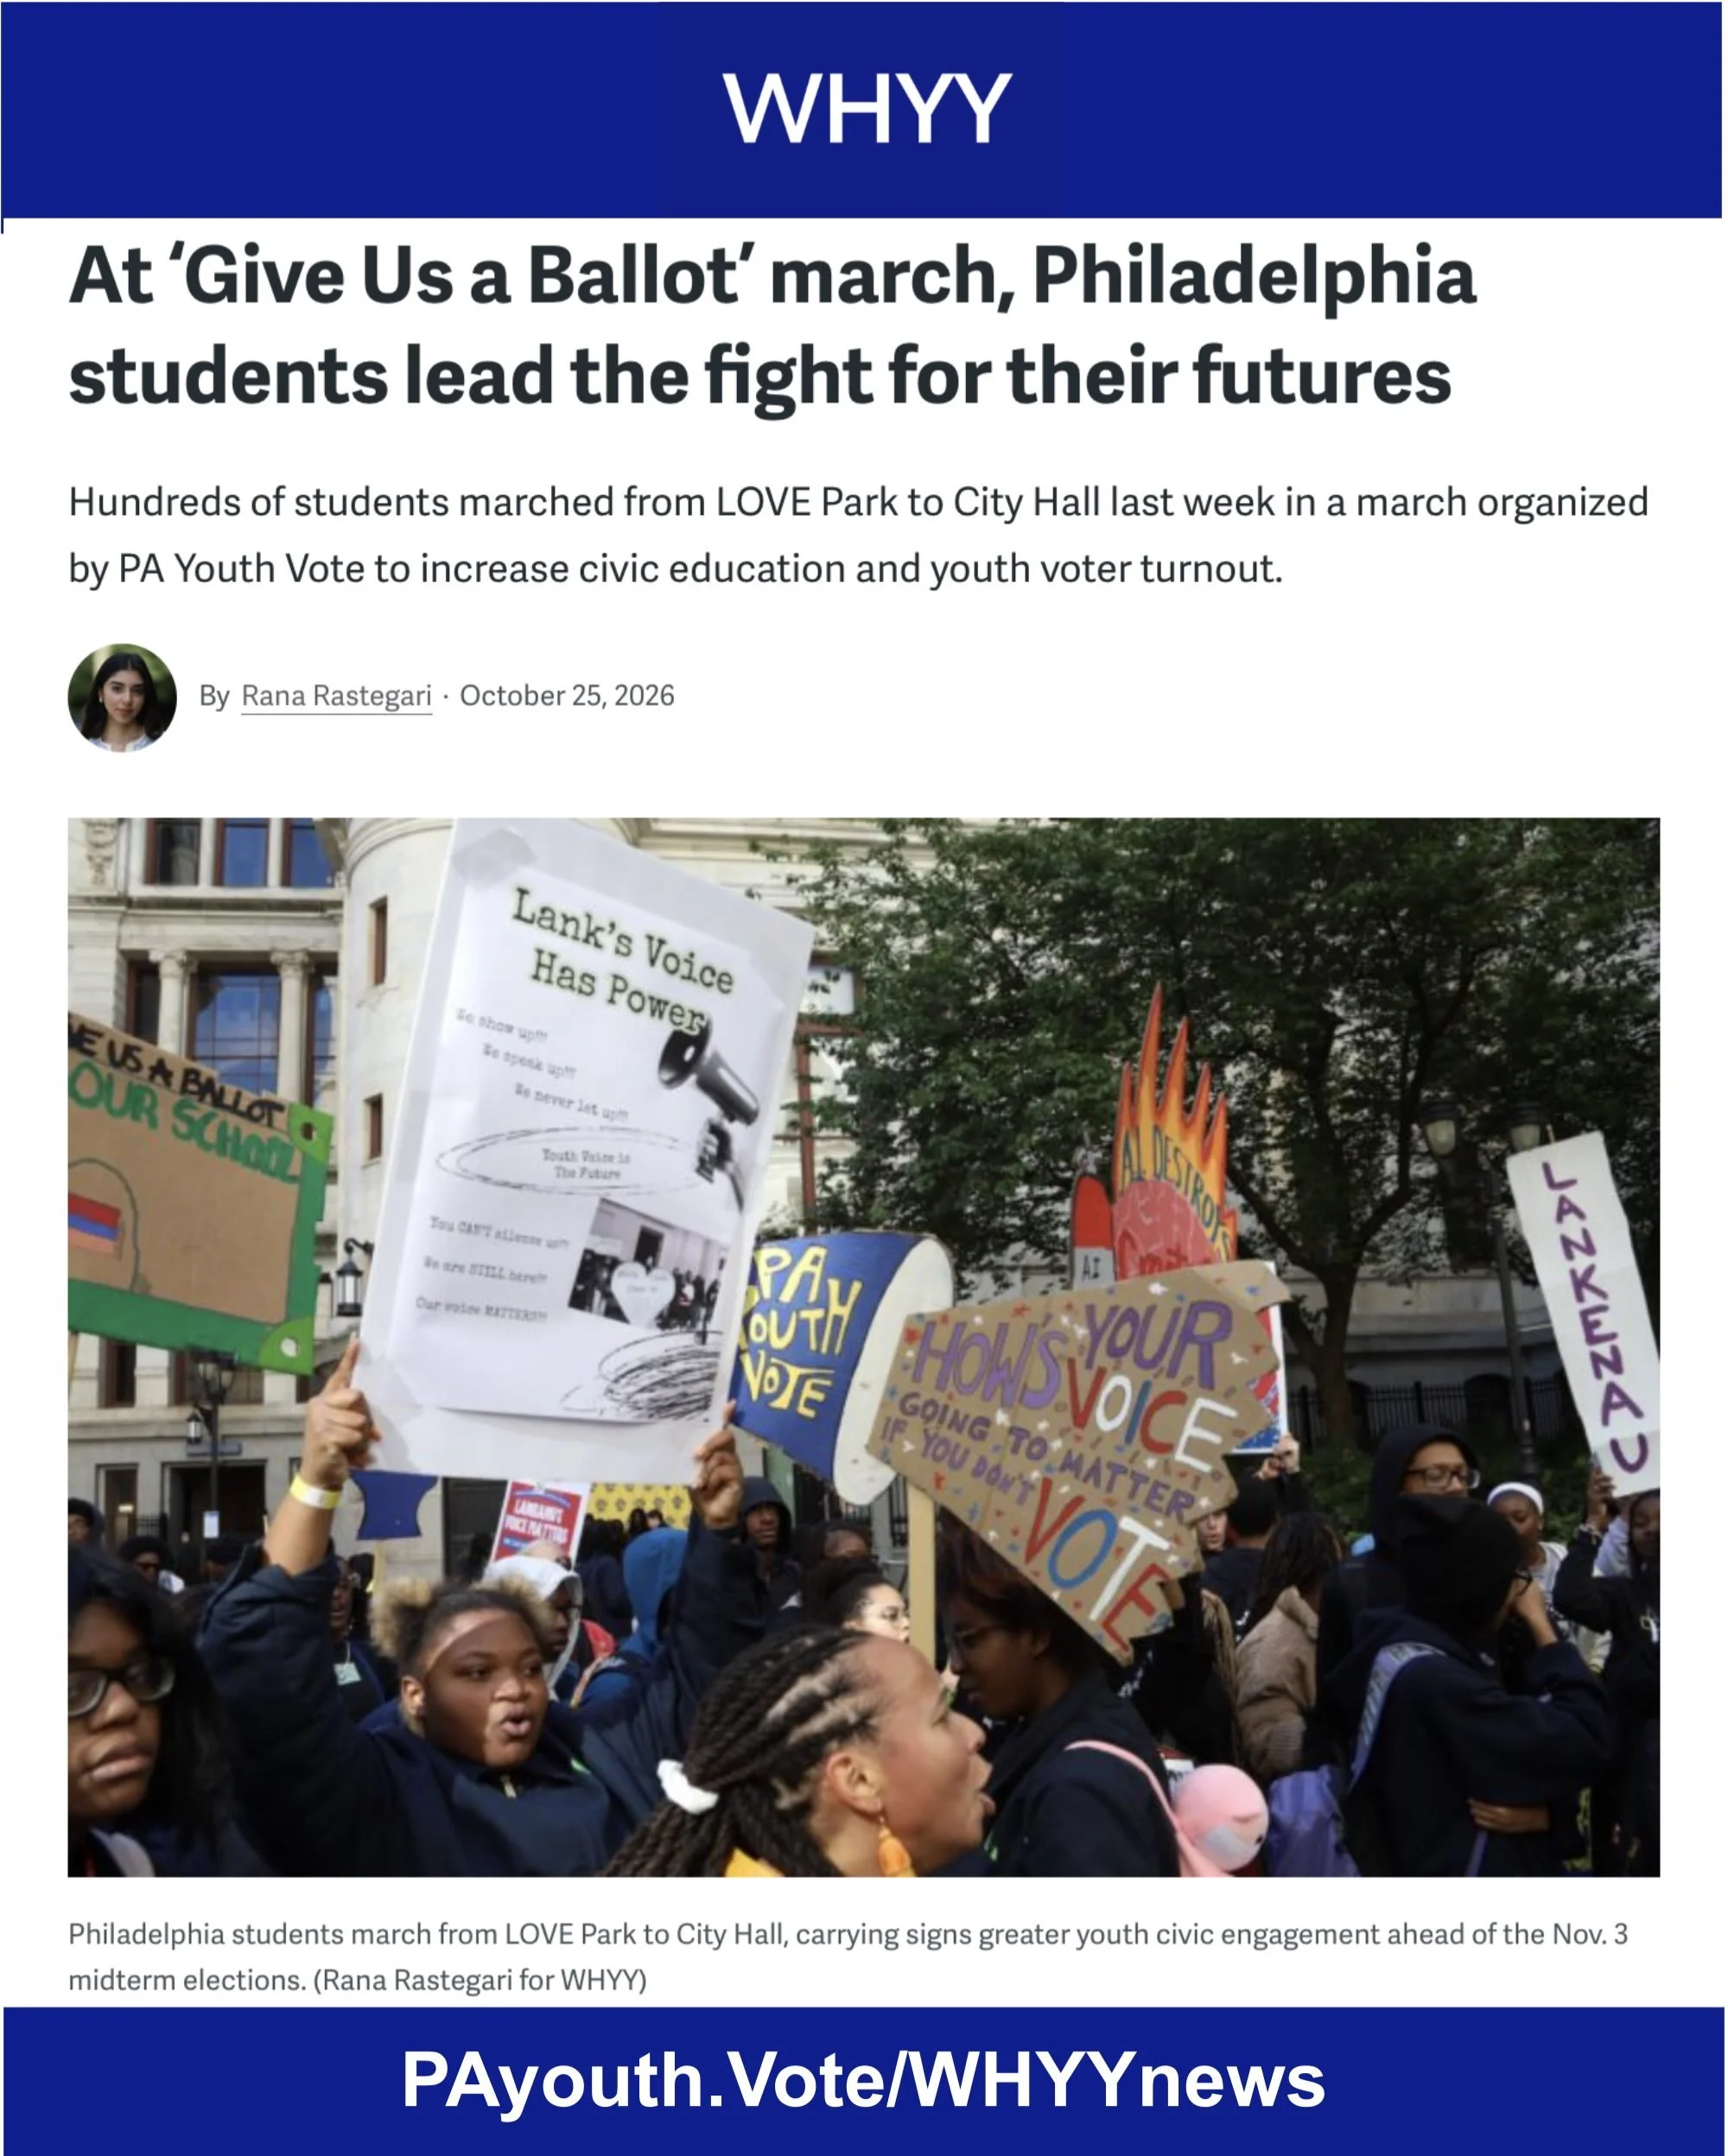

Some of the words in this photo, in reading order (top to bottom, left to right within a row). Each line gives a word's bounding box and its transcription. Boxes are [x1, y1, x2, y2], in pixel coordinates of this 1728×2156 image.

[512, 887, 633, 958] Lank's
[645, 934, 734, 995] Voice
[478, 1016, 514, 1035] show
[531, 948, 596, 997] Has
[607, 973, 707, 1033] Power
[108, 1040, 144, 1074] US
[148, 1057, 173, 1089] A
[180, 1068, 286, 1129] BALLOT
[503, 1050, 544, 1072] speak
[534, 1091, 575, 1109] never
[577, 1099, 599, 1116] let
[68, 1060, 159, 1131] OUR
[171, 1097, 299, 1184] SCHOOL
[543, 1148, 578, 1164] Youth
[581, 1150, 615, 1164] Voice
[555, 1166, 577, 1179] The
[580, 1167, 621, 1181] Future
[753, 1246, 828, 1304] PA
[1083, 1255, 1101, 1281] AI
[740, 1278, 862, 1355] OUTH
[1083, 1300, 1233, 1391] YOUR
[1542, 1161, 1649, 1474] LANKENAU
[740, 1350, 835, 1418] VOTE
[1067, 1357, 1239, 1474] VOICE
[880, 1417, 908, 1443] IF
[921, 1428, 970, 1471] YOU
[971, 1455, 1036, 1506] DON'T
[899, 1392, 992, 1442] GOING
[1008, 1426, 1048, 1462] TO
[1059, 1449, 1196, 1525] MATTER
[1025, 1477, 1172, 1655] VOTE
